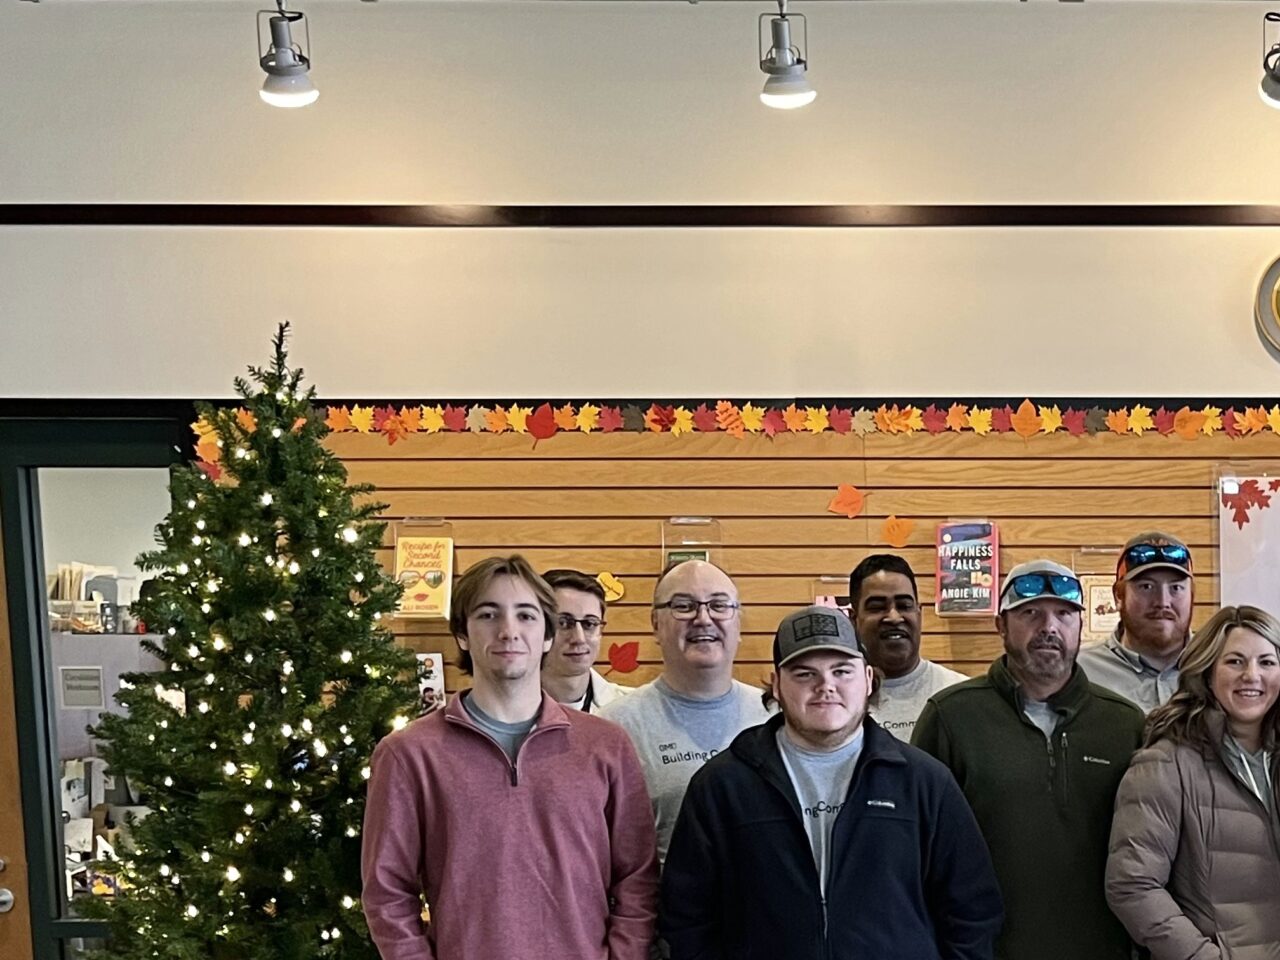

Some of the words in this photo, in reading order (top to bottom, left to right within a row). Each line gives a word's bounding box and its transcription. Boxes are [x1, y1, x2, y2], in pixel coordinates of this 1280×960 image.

[937, 545, 994, 557] HAPPINESS
[950, 559, 982, 570] FALLS
[941, 588, 969, 599] ANGIE
[972, 588, 991, 599] KIM
[661, 750, 708, 765] Building
